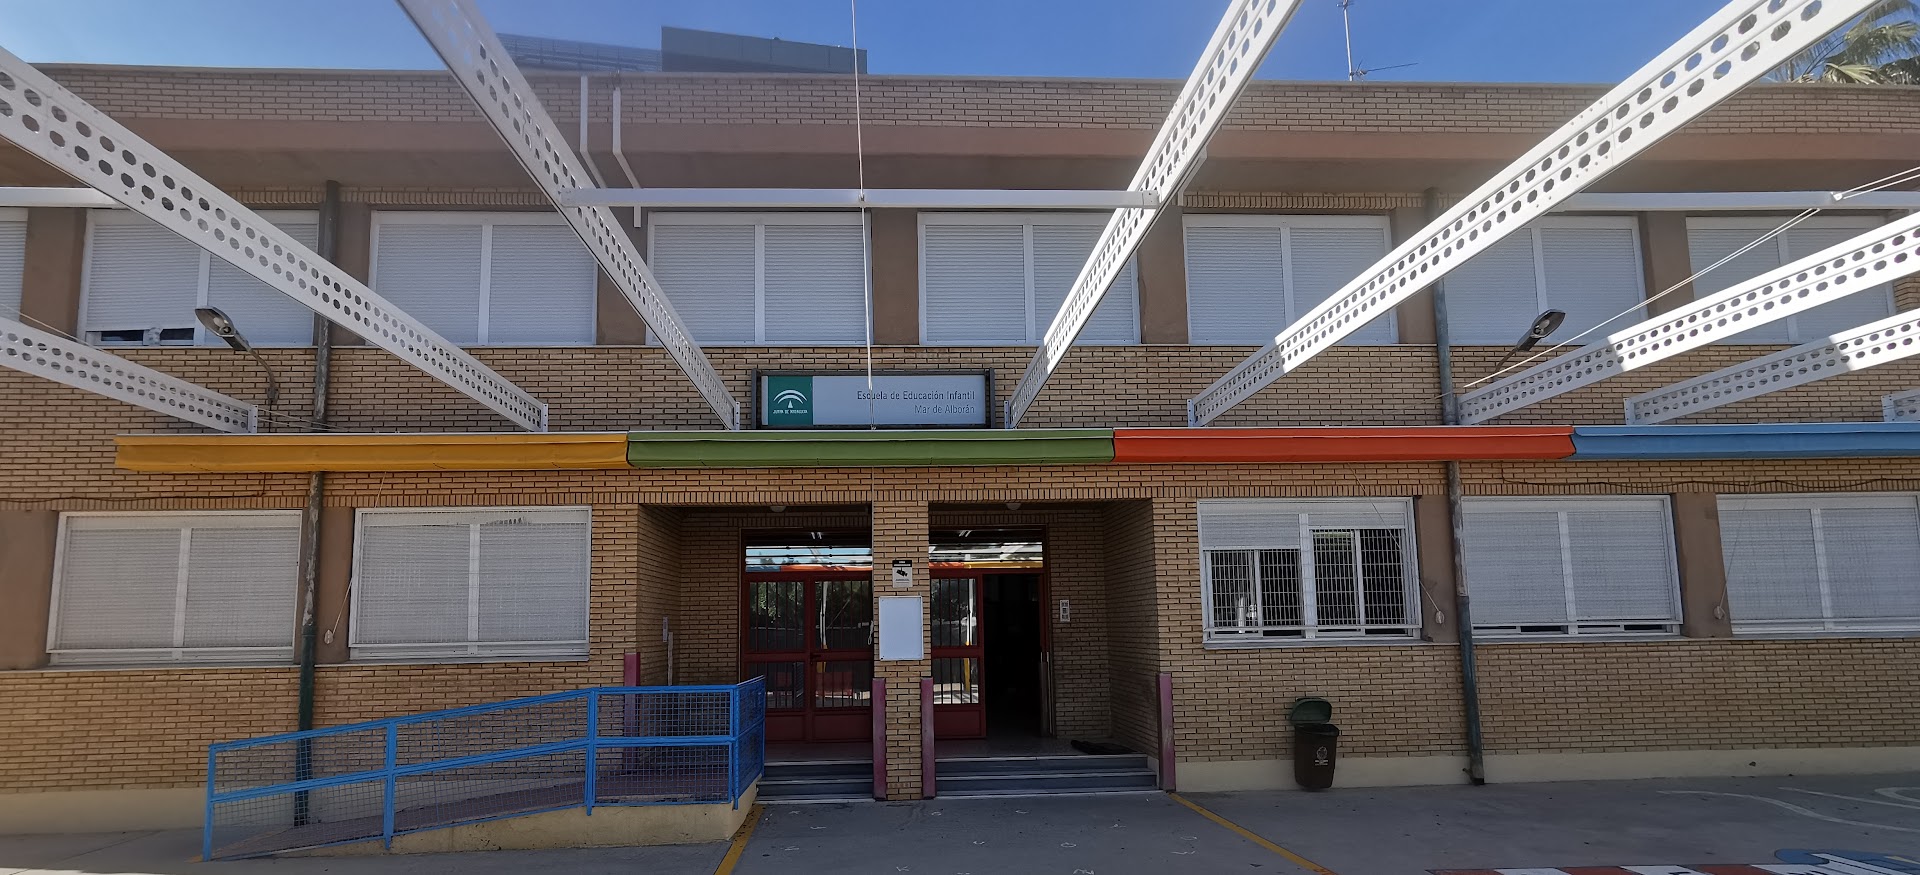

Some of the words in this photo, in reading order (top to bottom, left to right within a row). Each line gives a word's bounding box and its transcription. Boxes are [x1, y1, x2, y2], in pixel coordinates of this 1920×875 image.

[857, 390, 887, 400] Escuela
[890, 390, 900, 400] de
[903, 390, 944, 400] Educación
[946, 390, 975, 400] Infantil
[914, 404, 930, 414] Mar
[932, 404, 942, 414] de
[944, 404, 975, 414] Alborán
